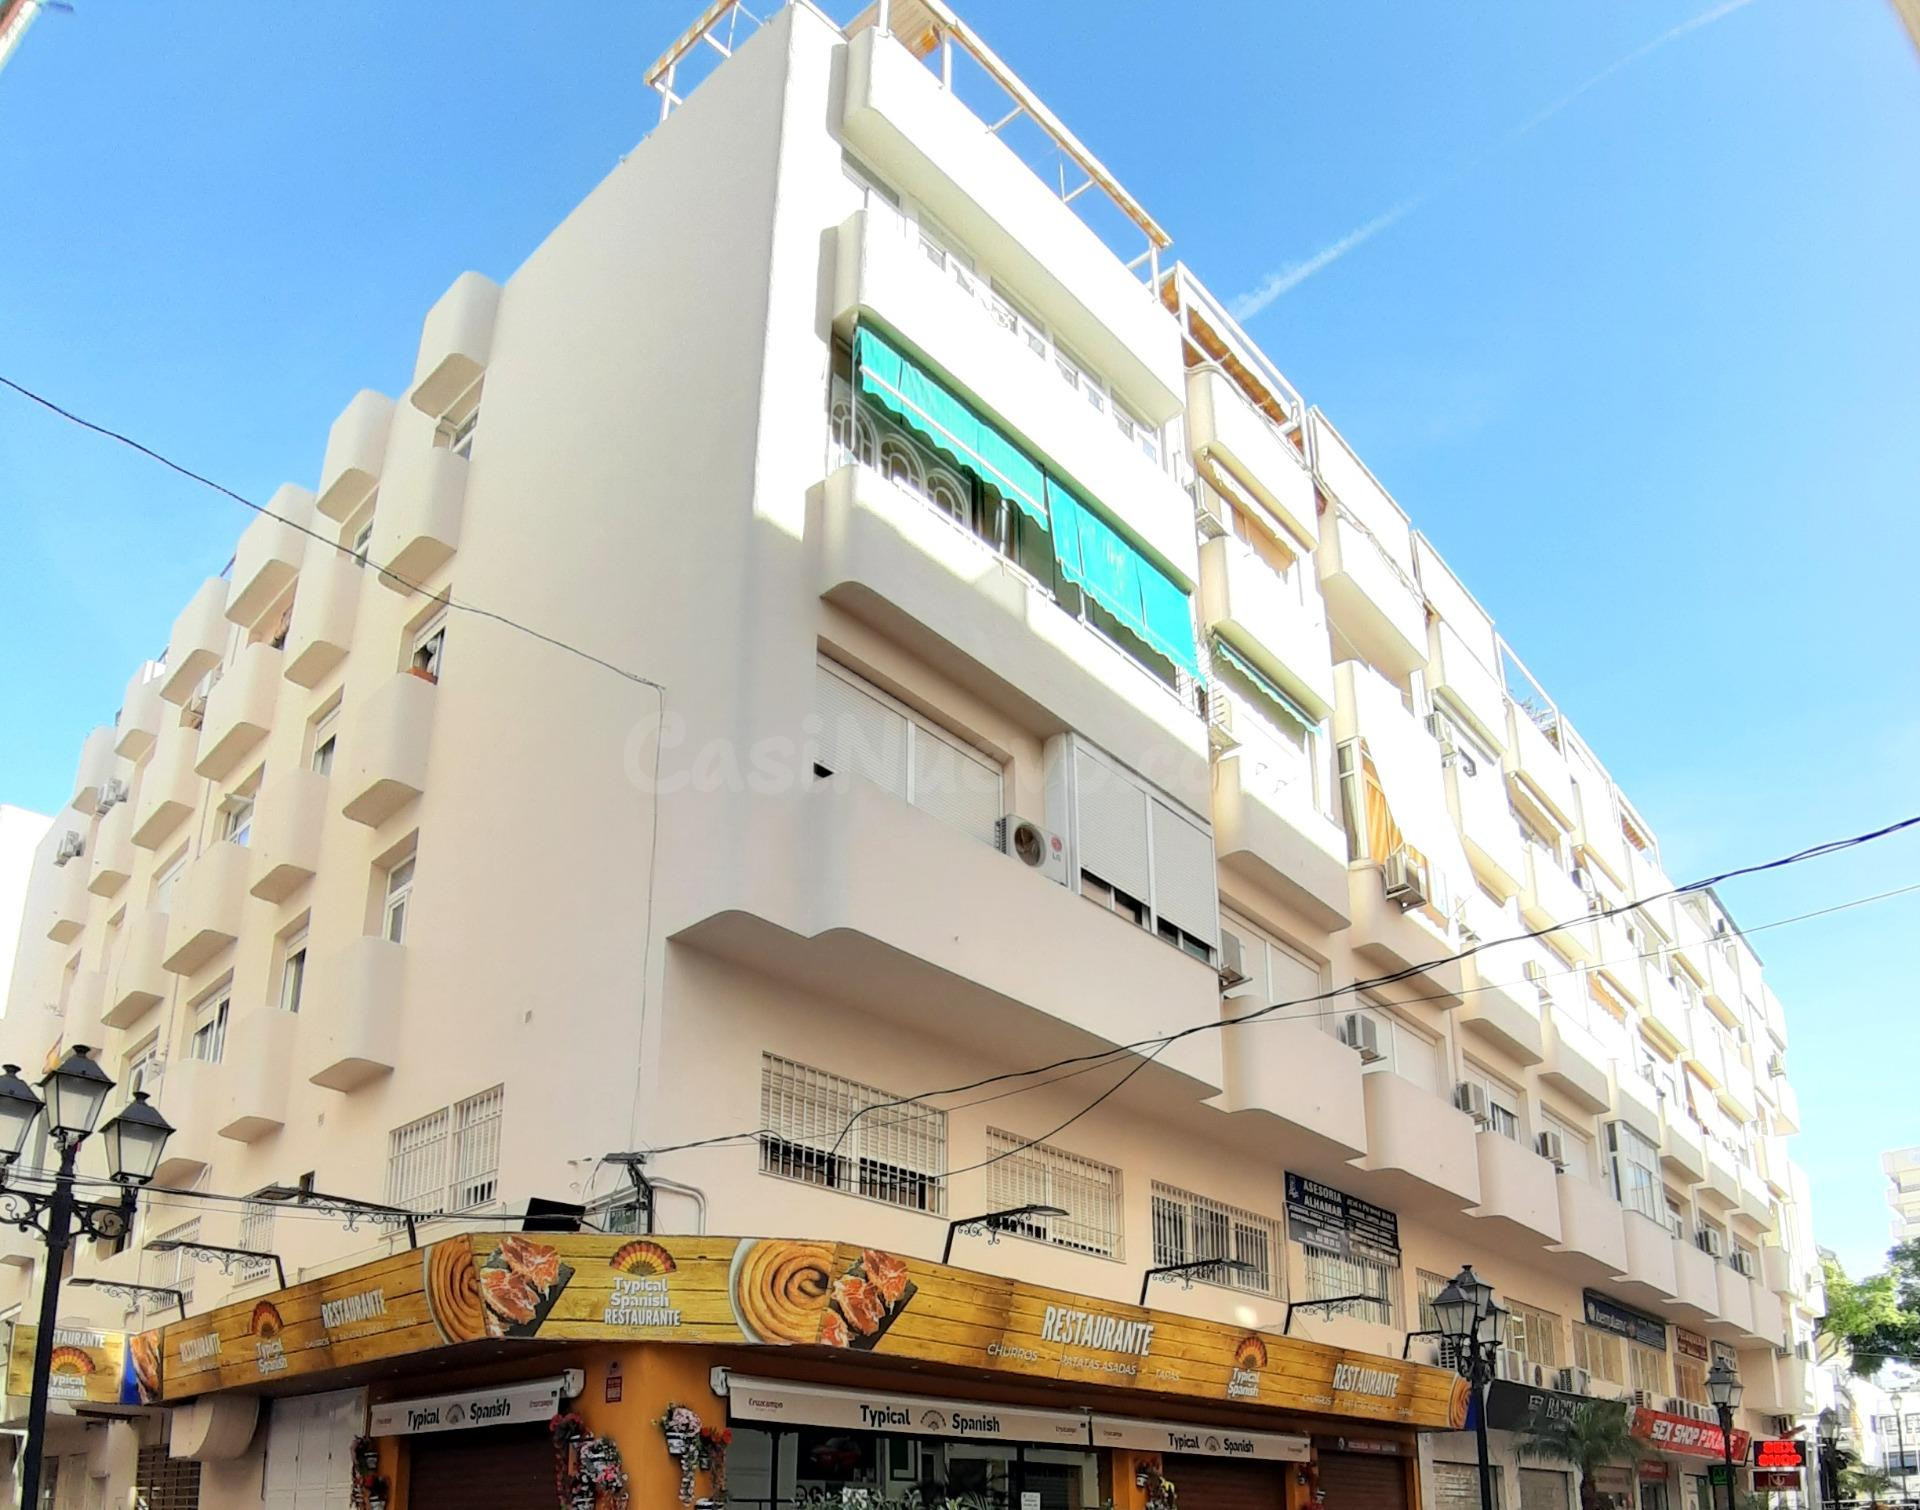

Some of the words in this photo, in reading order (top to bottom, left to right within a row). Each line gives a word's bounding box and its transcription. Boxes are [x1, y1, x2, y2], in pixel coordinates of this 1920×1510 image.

[1303, 1180, 1342, 1204] ASESORIA
[1304, 1195, 1343, 1218] ALHAMAR
[613, 1277, 668, 1295] Typical
[321, 1289, 387, 1329] RESTAURANTE
[610, 1292, 669, 1309] Spanish
[604, 1308, 681, 1327] RESTAURANTE
[1042, 1306, 1154, 1357] RESTAURANTE
[256, 1338, 284, 1360] Typical
[987, 1343, 1039, 1362] CHURROS
[258, 1356, 288, 1375] Spanish
[50, 1375, 87, 1387] ypical
[1231, 1367, 1260, 1385] Typical
[1332, 1363, 1400, 1398] RESTAURANTE
[48, 1387, 87, 1398] panish
[1227, 1382, 1259, 1398] Spanish
[407, 1408, 440, 1430] Typical
[470, 1398, 511, 1422] Spanish
[860, 1404, 911, 1427] Typical
[951, 1413, 1000, 1435] Spanish
[1651, 1419, 1673, 1441] SEX
[1673, 1424, 1700, 1446] SHOP
[1168, 1433, 1199, 1452] Typical
[1223, 1438, 1253, 1454] Spanish
[1763, 1441, 1796, 1453] SEX
[1758, 1454, 1802, 1467] SHOP
